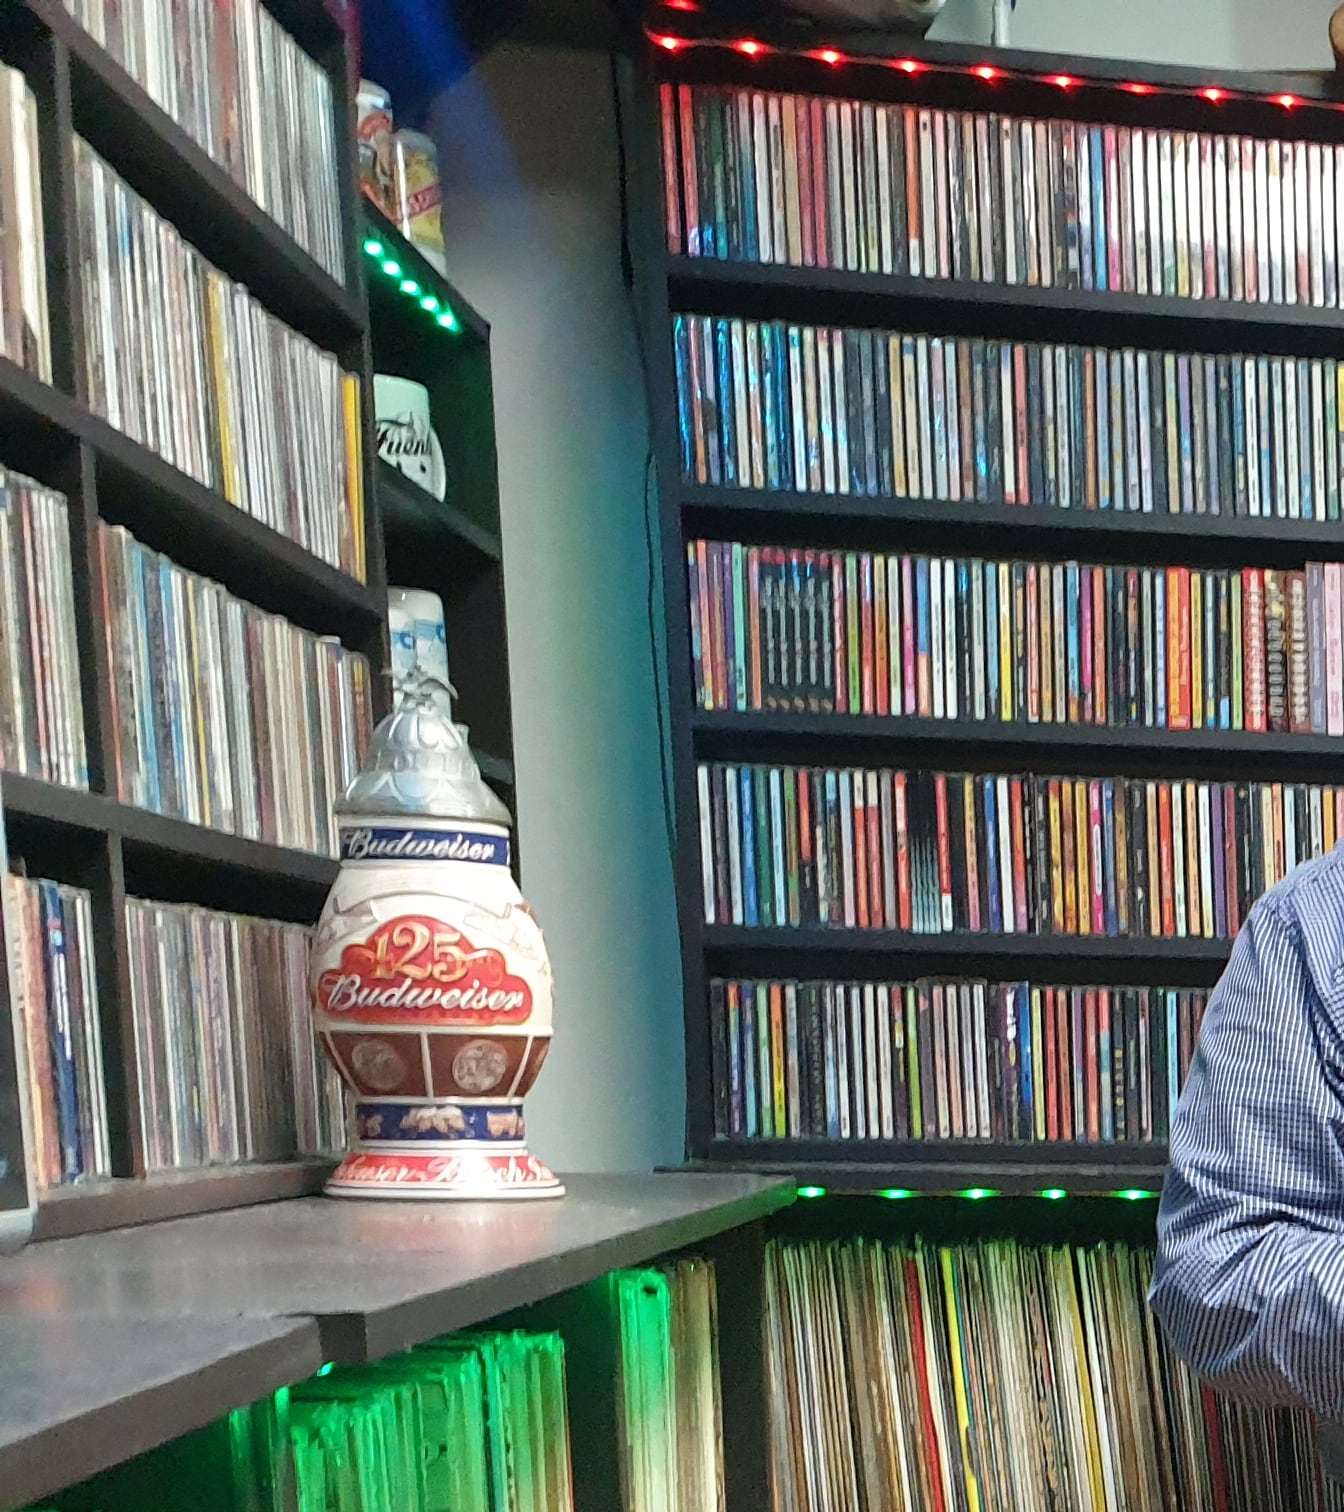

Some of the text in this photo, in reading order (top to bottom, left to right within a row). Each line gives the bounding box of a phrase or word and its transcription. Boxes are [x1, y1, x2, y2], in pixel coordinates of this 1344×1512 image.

[343, 828, 495, 861] Budweiser
[371, 920, 470, 983] 125
[325, 973, 525, 1011] Budweiser
